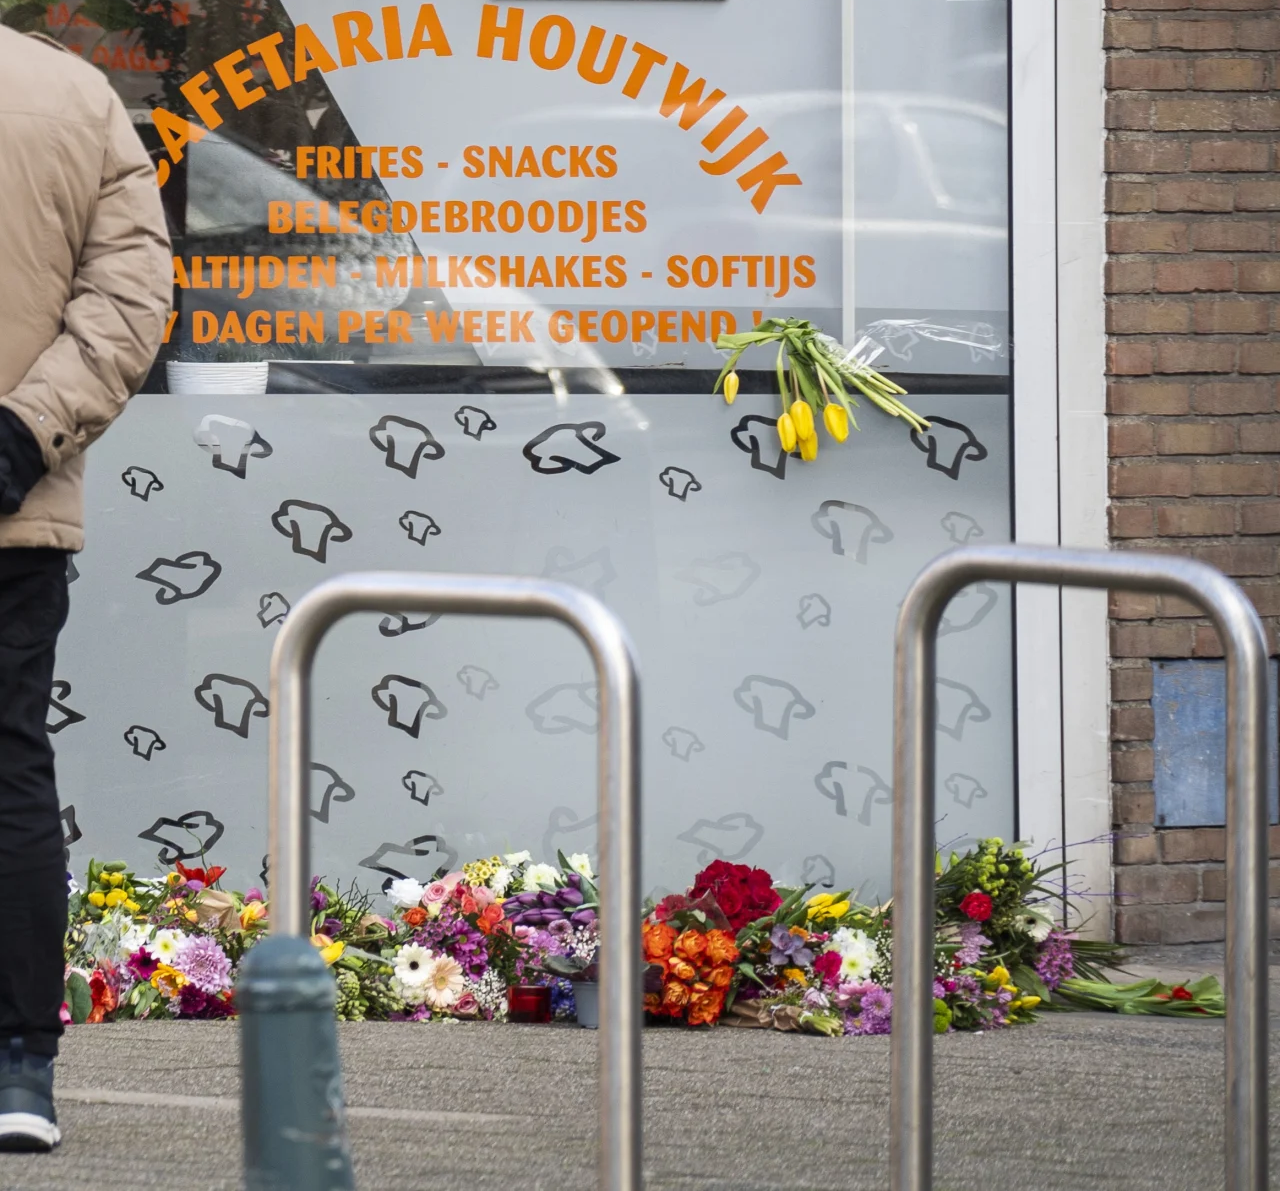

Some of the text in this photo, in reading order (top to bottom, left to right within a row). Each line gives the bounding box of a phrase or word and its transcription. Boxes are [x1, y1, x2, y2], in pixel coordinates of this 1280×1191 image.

[476, 4, 804, 216] HOUTWIJK
[295, 145, 424, 180] FRITES
[462, 144, 619, 180] SNACKS
[267, 199, 648, 243] BELEGDEBROODJES
[172, 255, 337, 299] ALTIJDEN
[374, 254, 628, 290] MILKSHAKES
[665, 254, 817, 299] SOFTIJS
[191, 310, 325, 344] DAGEN
[340, 310, 412, 344] PER
[424, 310, 537, 344] WEEK
[547, 309, 738, 344] GEOPEND
